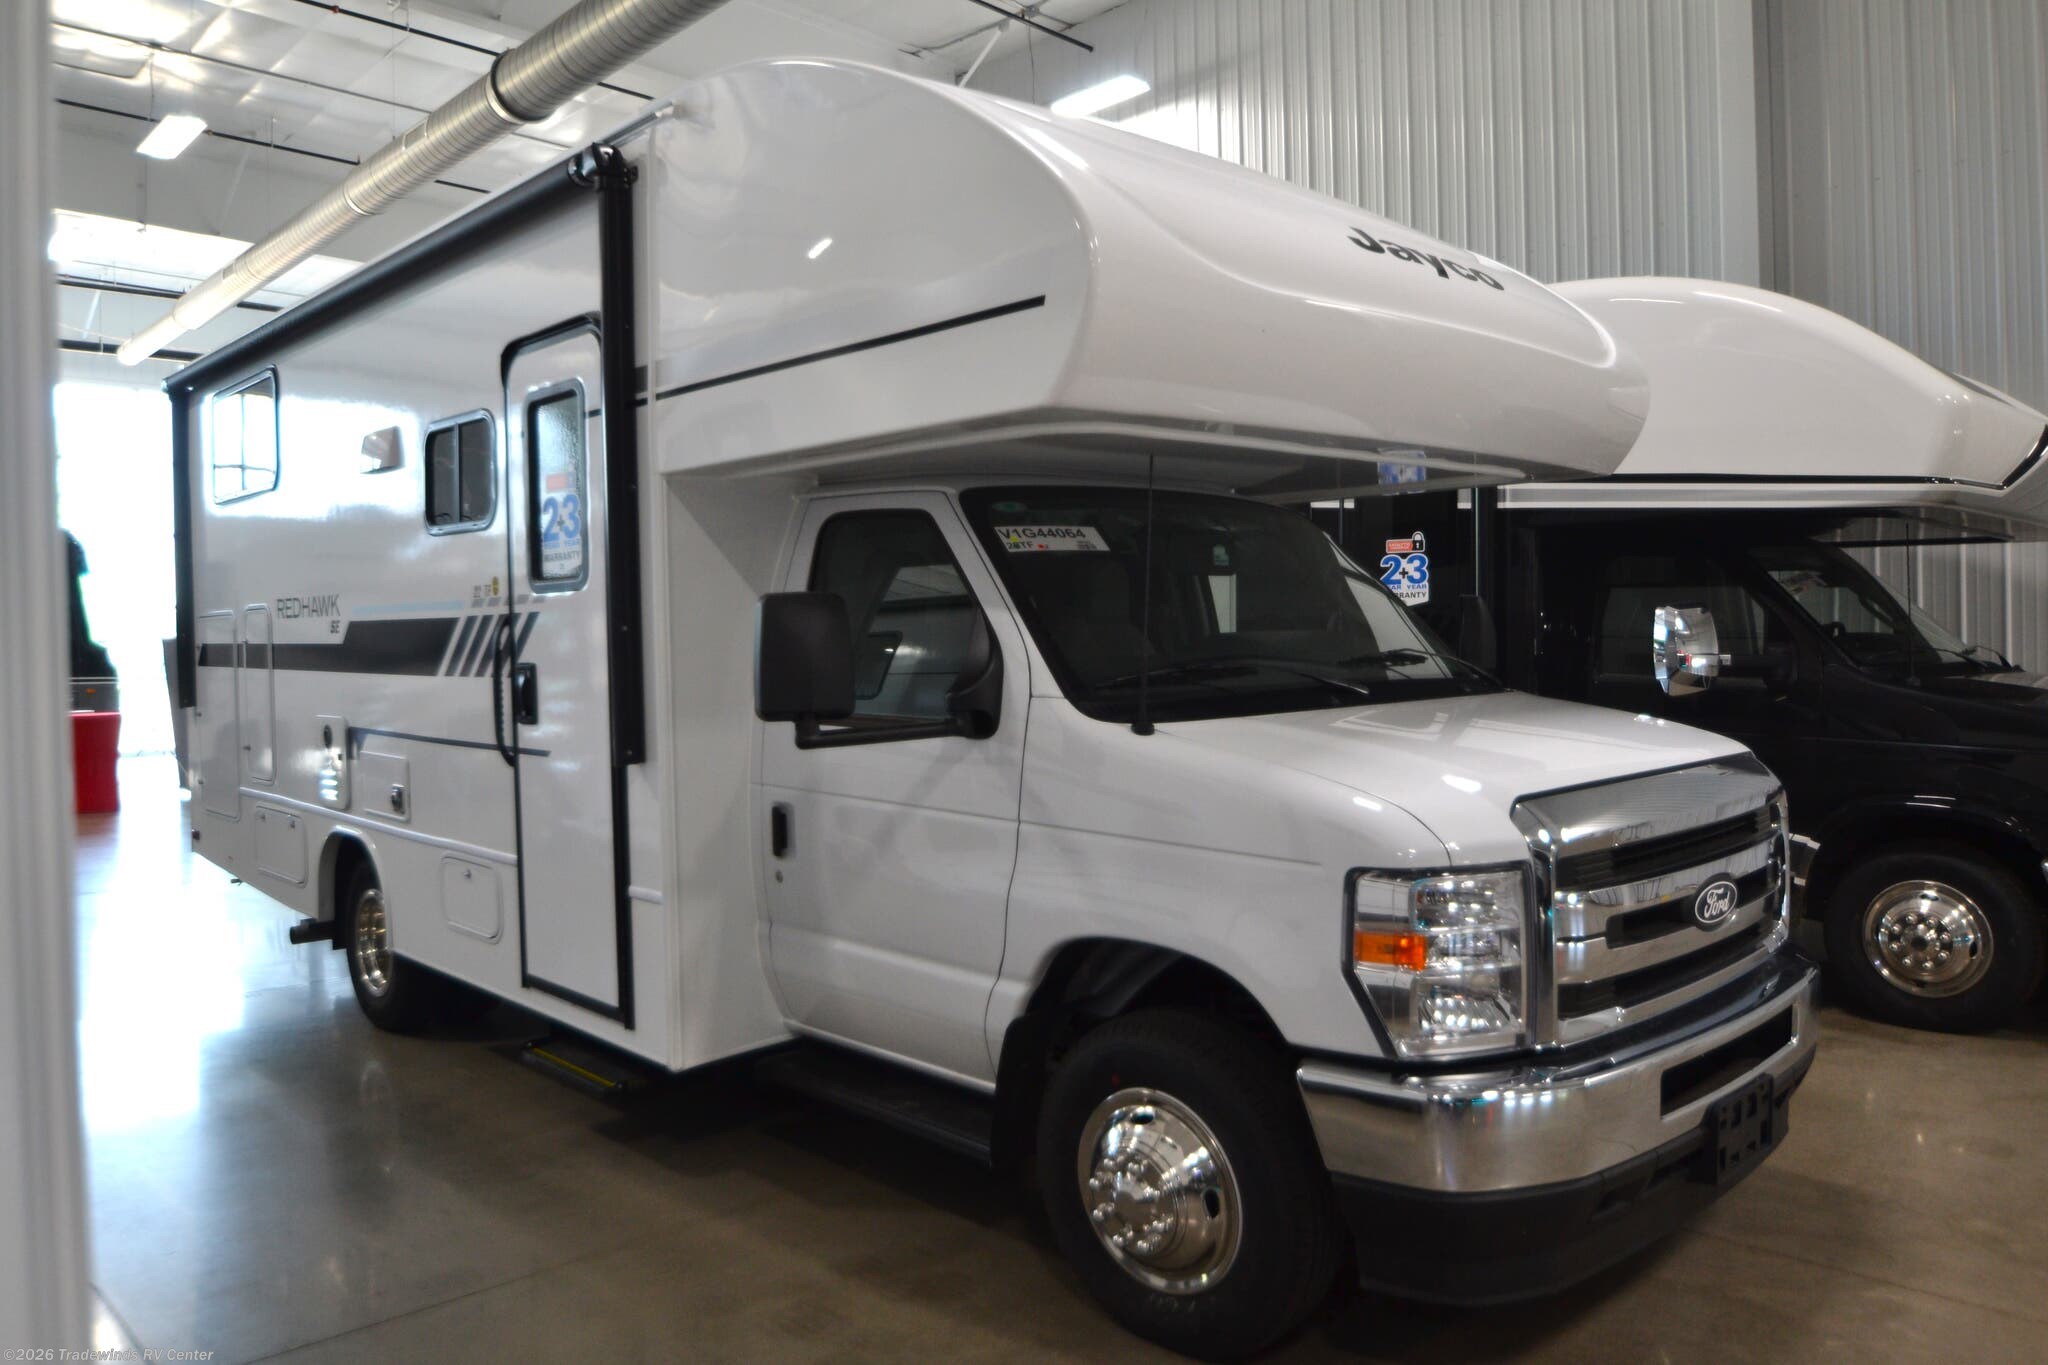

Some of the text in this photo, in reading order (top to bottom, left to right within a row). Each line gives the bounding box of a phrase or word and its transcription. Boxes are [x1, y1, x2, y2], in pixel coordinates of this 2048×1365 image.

[1347, 226, 1505, 291] Jayco
[277, 594, 341, 619] REDHAWK
[330, 620, 341, 634] SE
[1704, 887, 1730, 918] Ford
